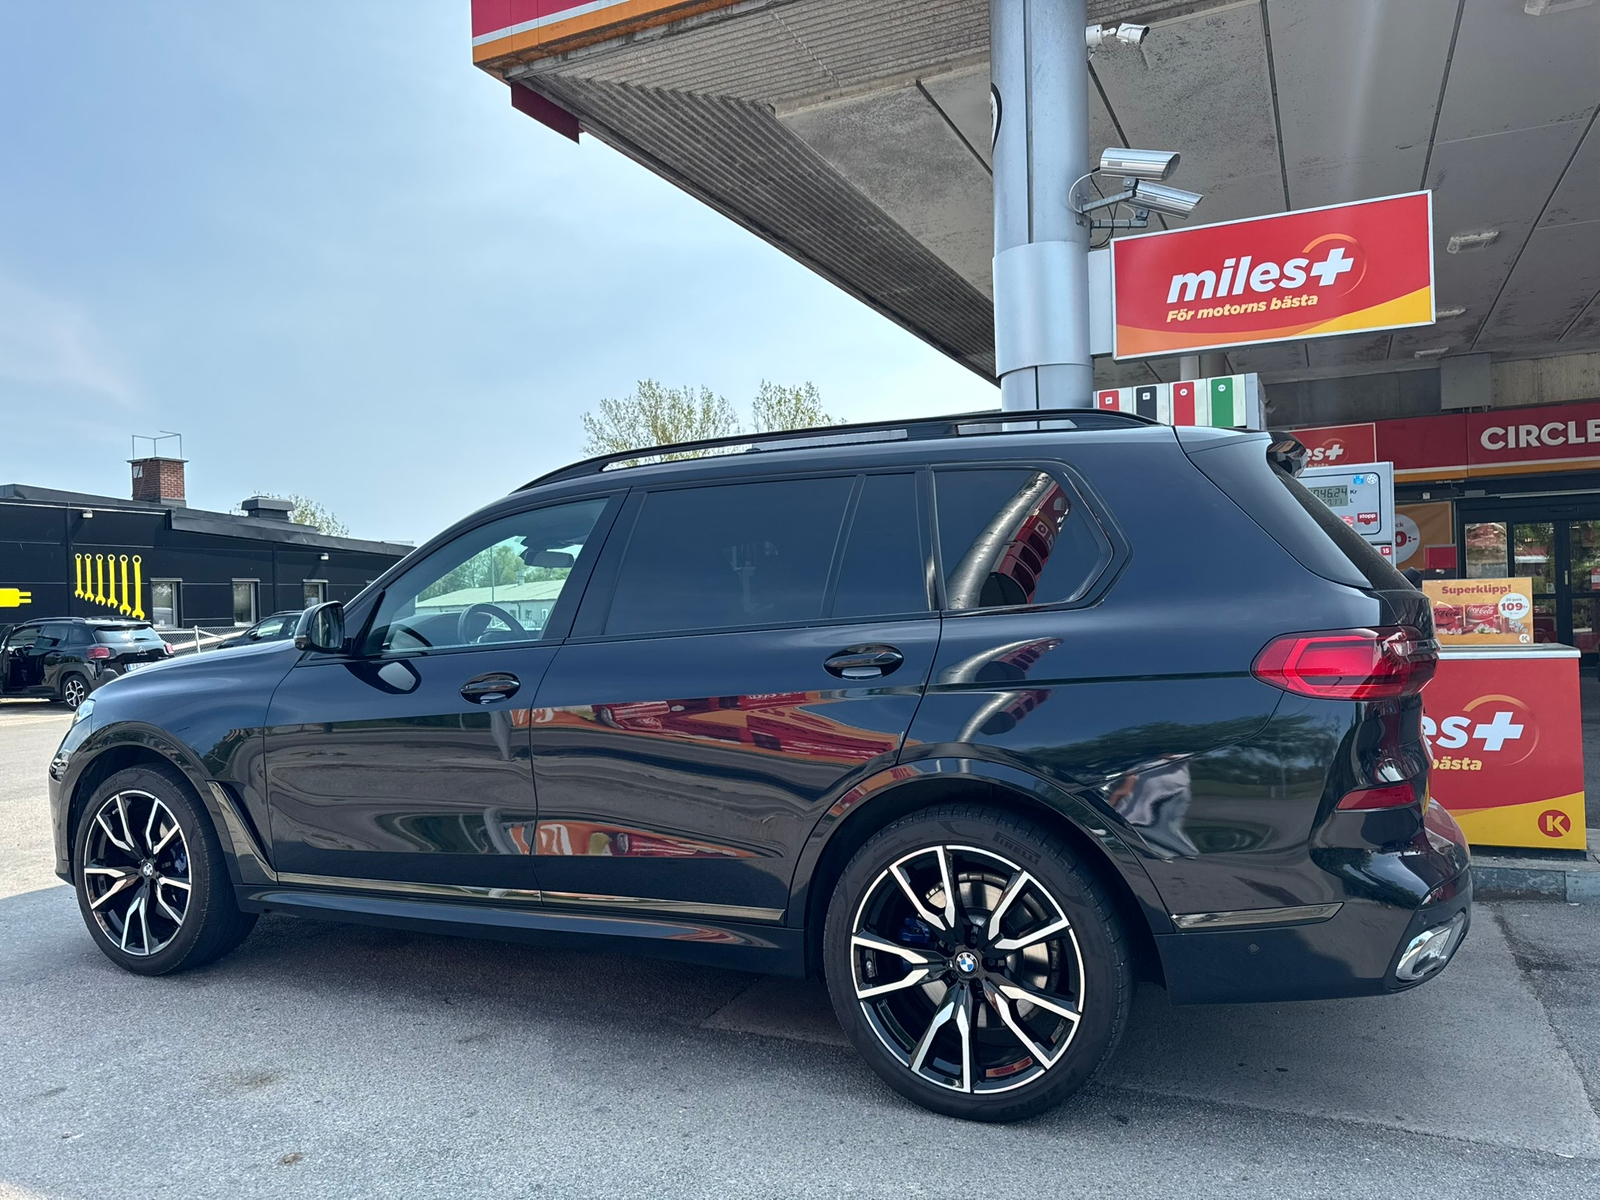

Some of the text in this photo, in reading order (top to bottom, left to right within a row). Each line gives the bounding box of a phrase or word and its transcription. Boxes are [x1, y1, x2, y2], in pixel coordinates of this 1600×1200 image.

[1166, 294, 1318, 322] För motorns bästa
[1481, 419, 1600, 450] CIRCLE
[1442, 584, 1512, 595] Superklipp!
[993, 831, 1041, 865] PIRELLI
